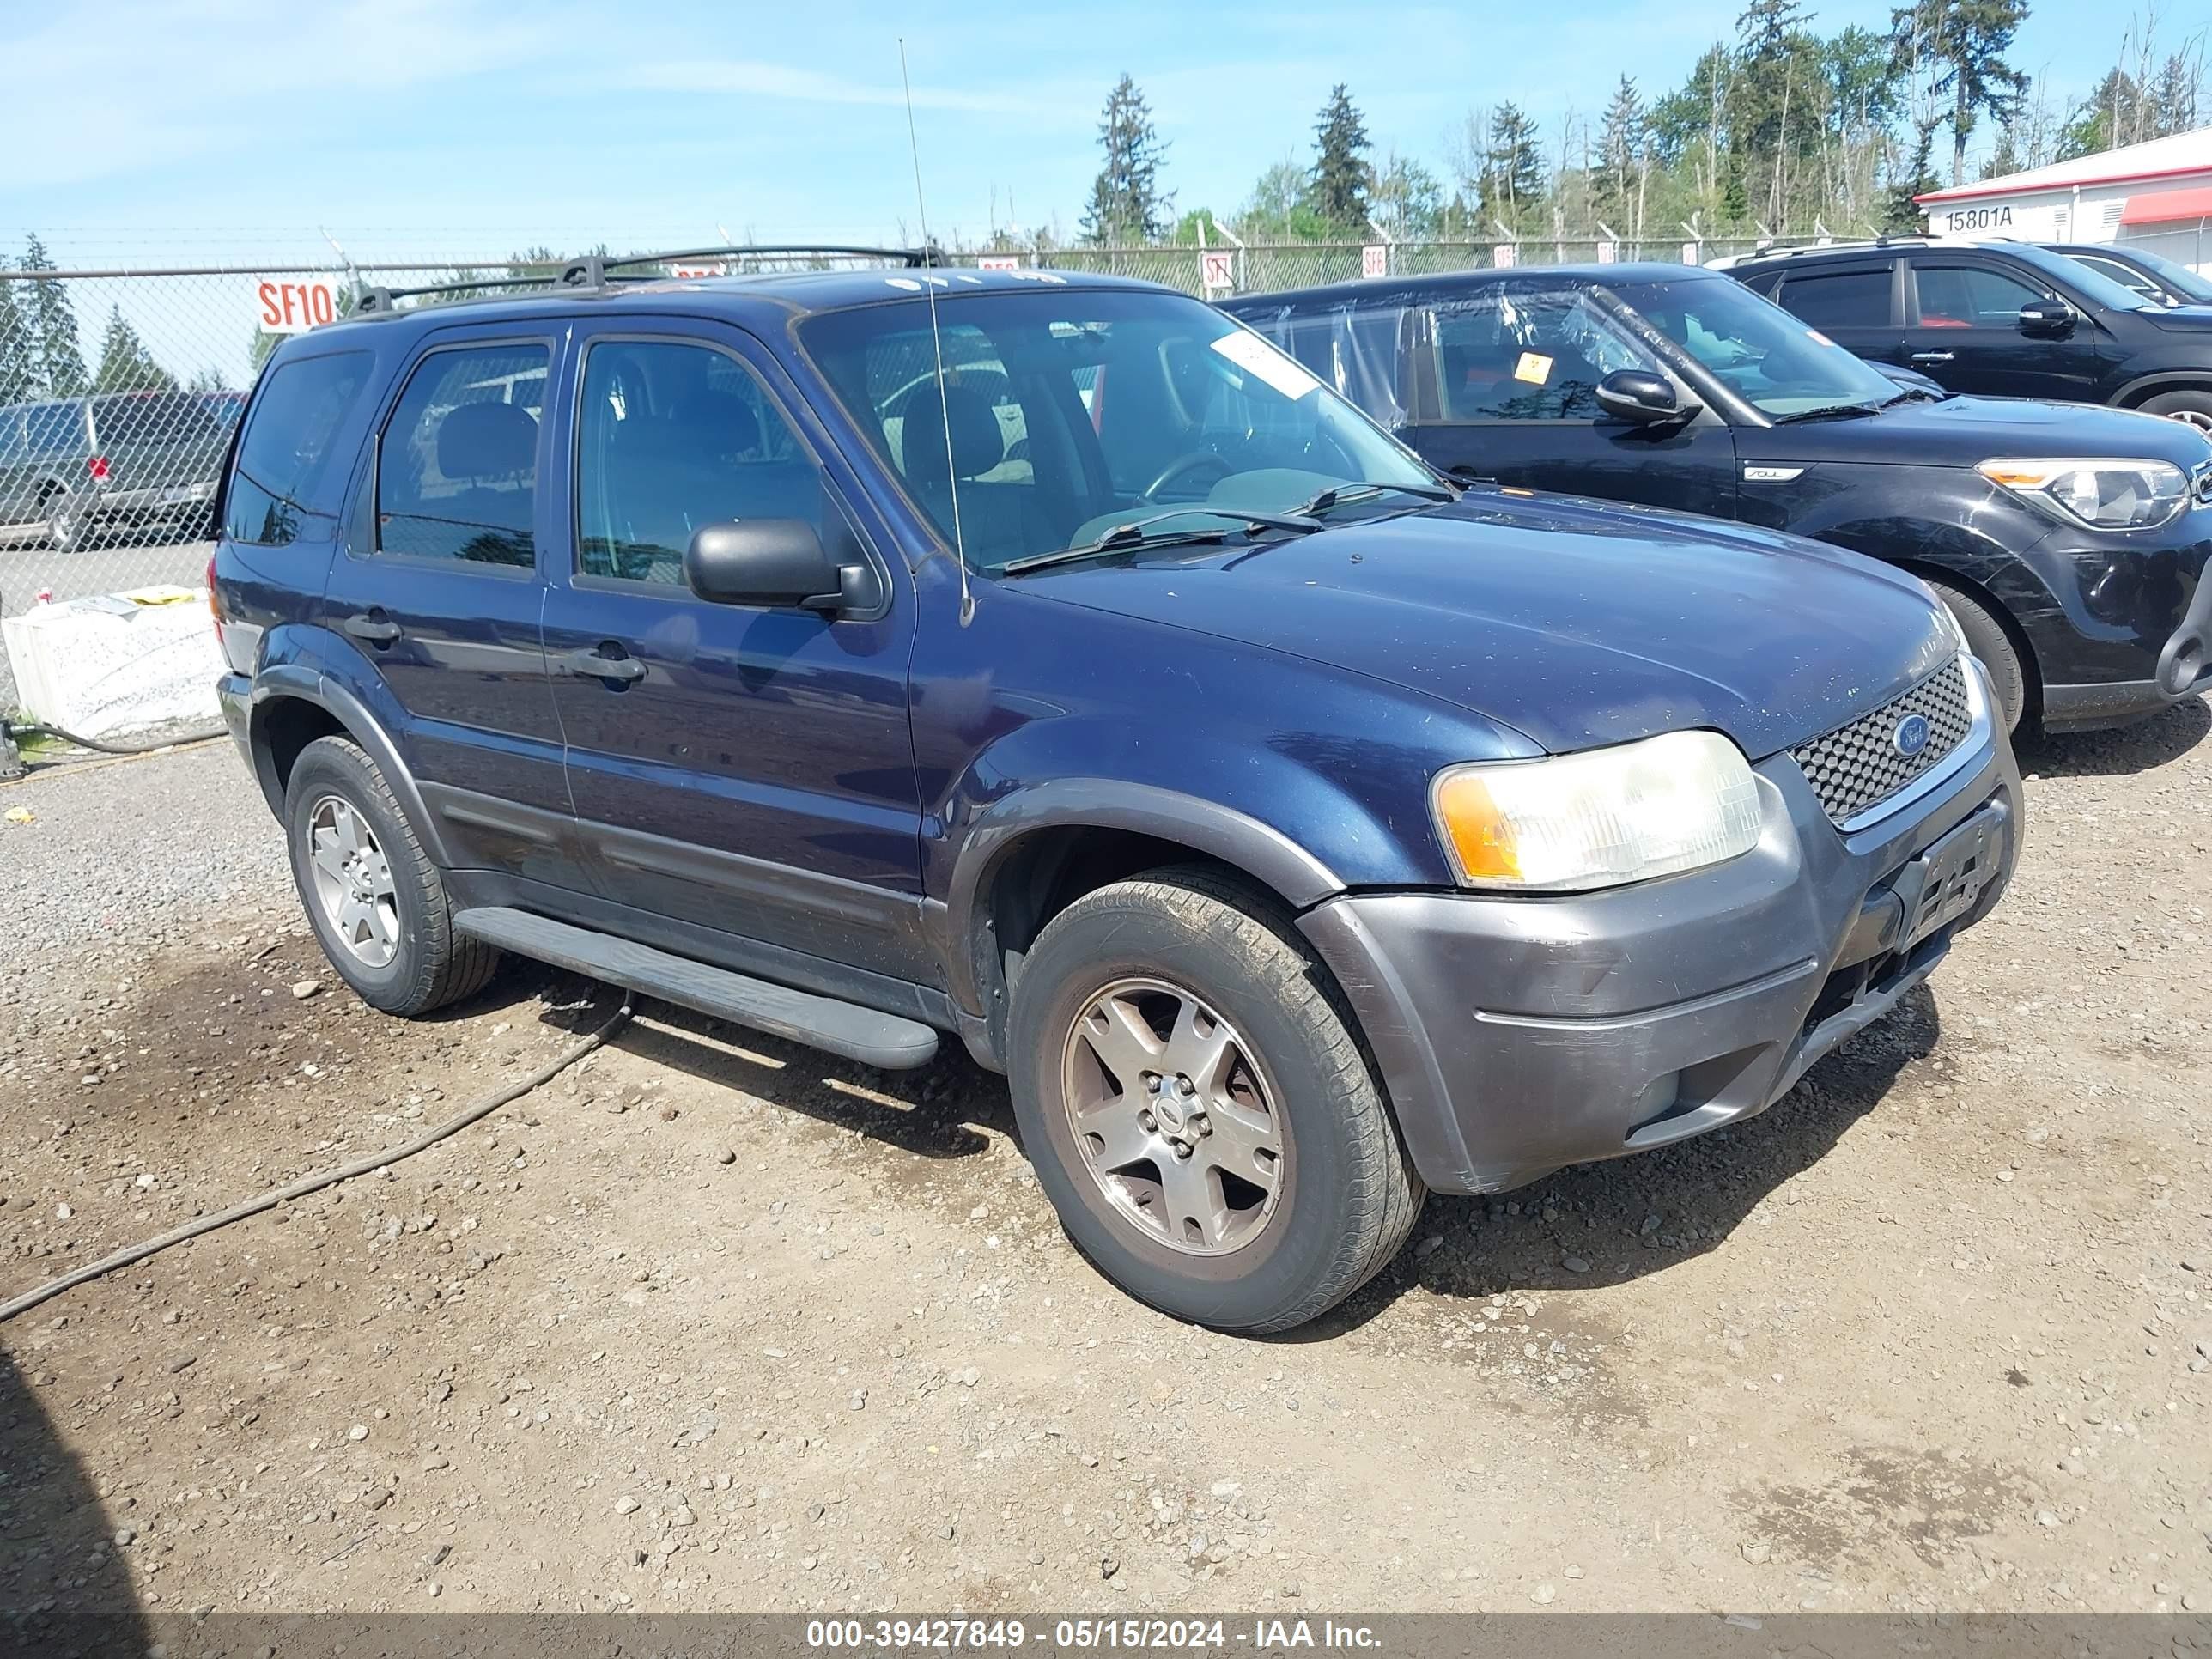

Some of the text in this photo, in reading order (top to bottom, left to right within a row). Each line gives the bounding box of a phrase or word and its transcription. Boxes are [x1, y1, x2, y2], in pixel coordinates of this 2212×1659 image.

[1946, 206, 2013, 232] 15801A
[1206, 258, 1228, 283] SF7
[1365, 251, 1383, 274] SF6
[259, 283, 333, 325] SF10
